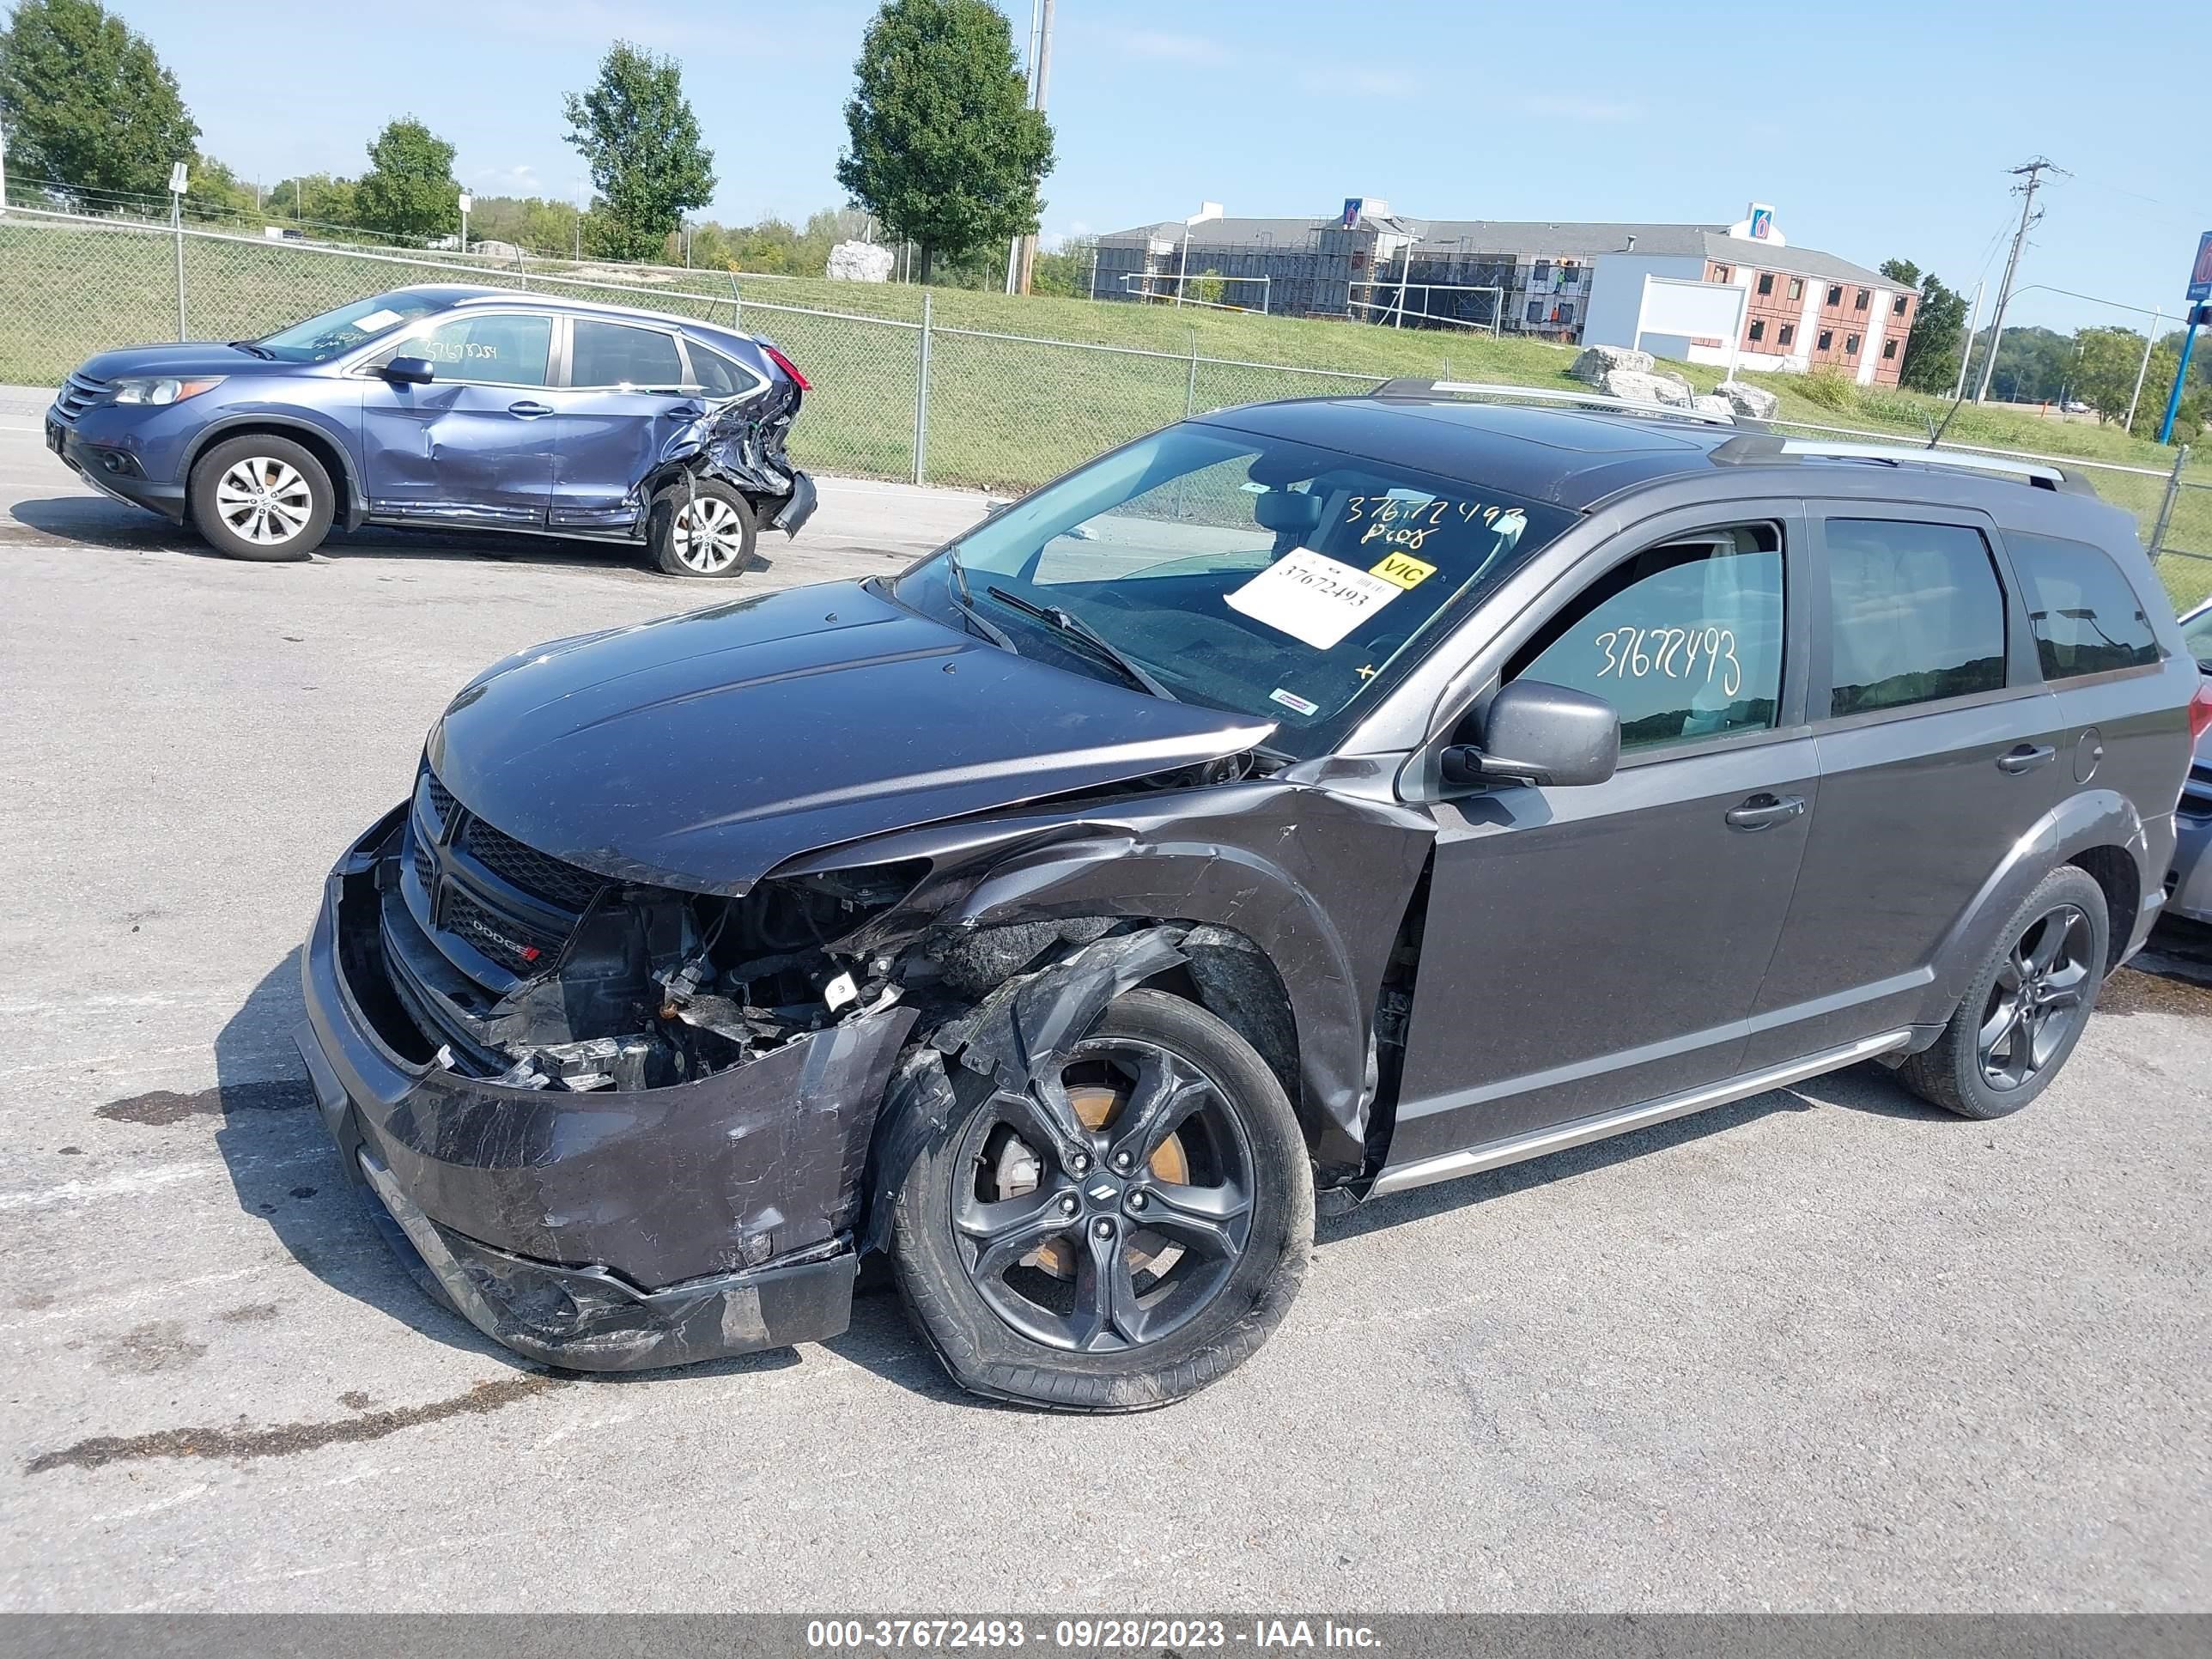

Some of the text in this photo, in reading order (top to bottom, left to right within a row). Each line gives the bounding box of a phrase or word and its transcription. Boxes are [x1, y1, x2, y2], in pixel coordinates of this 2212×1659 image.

[1755, 211, 1769, 238] 6
[1279, 565, 1370, 608] 37672493
[1384, 558, 1425, 582] VIC
[1595, 627, 1741, 696] 37672493
[473, 920, 530, 957] DODGE
